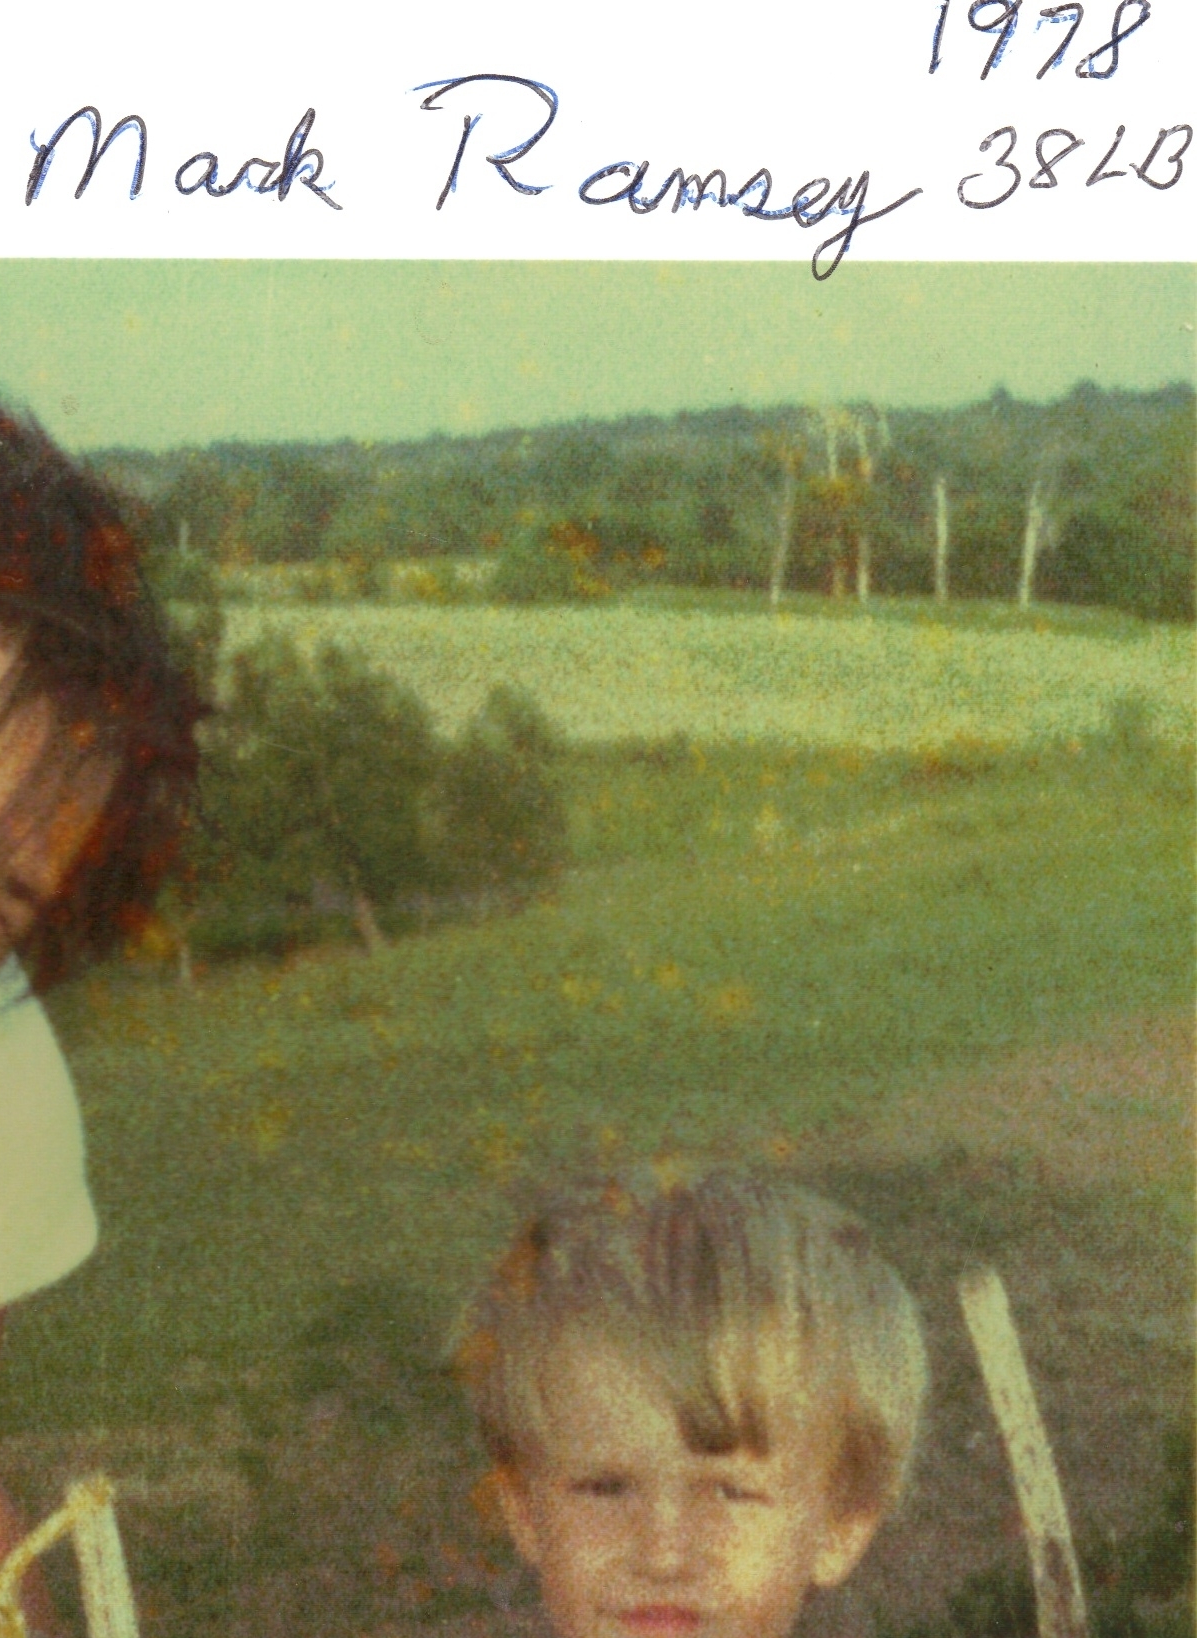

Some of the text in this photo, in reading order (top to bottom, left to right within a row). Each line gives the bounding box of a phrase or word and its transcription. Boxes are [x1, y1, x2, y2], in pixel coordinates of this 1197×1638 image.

[929, 0, 1151, 80] 1978
[25, 106, 343, 210] Mark
[411, 74, 923, 281] Ramsey
